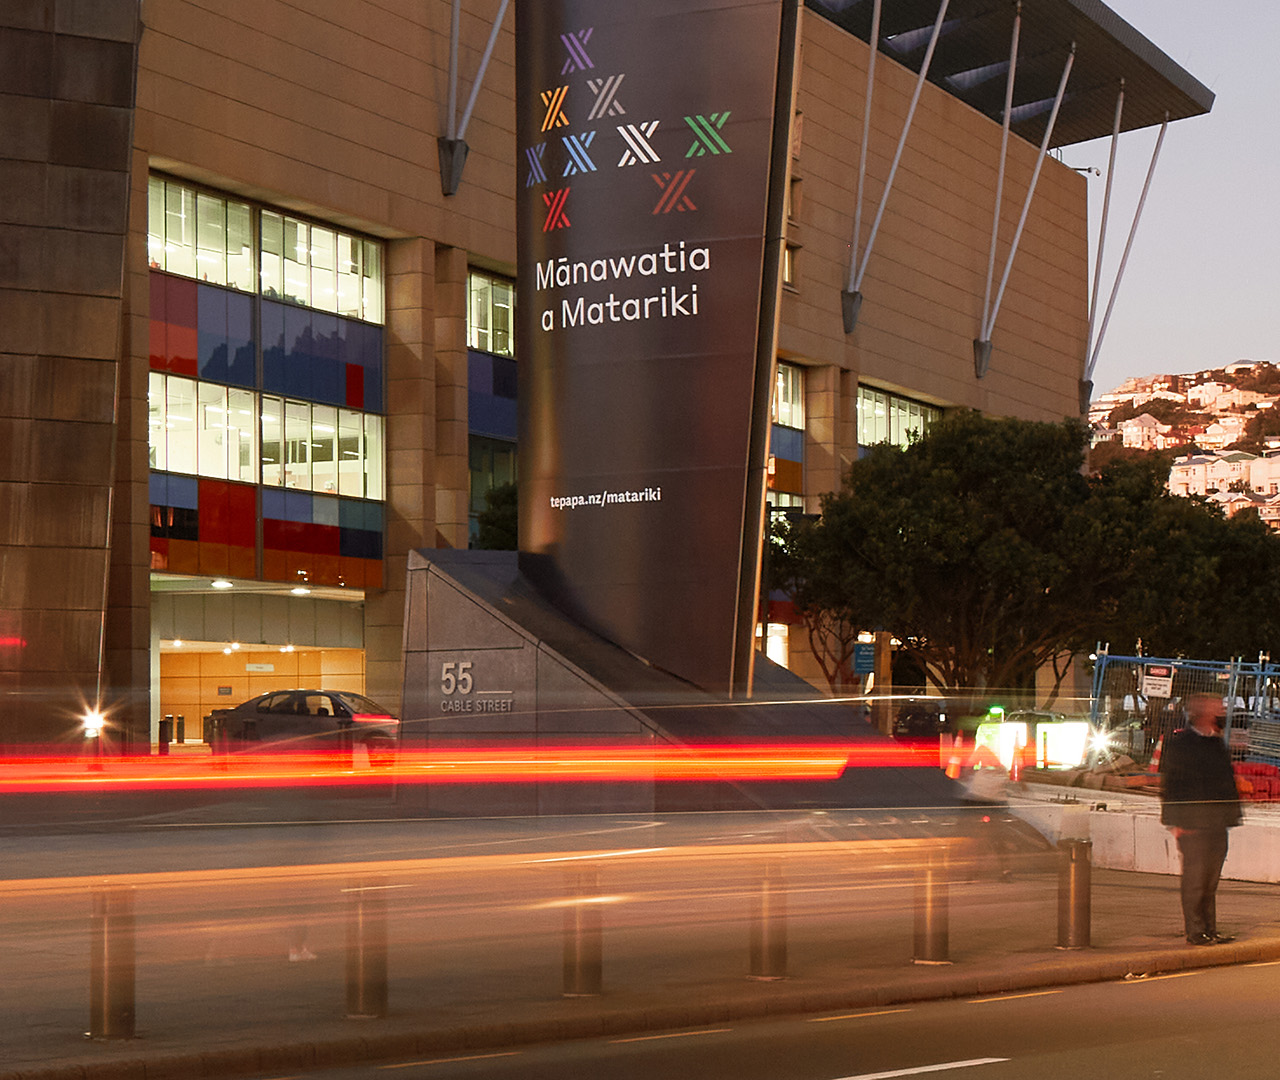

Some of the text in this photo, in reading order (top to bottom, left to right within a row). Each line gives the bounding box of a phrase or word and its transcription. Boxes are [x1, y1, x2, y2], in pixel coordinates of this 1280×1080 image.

[536, 241, 710, 291] Mānawatia
[541, 284, 698, 331] a Matariki
[550, 487, 661, 510] tepapa.nz/matariki
[441, 662, 473, 695] 55
[440, 699, 513, 712] CABLE STREET
